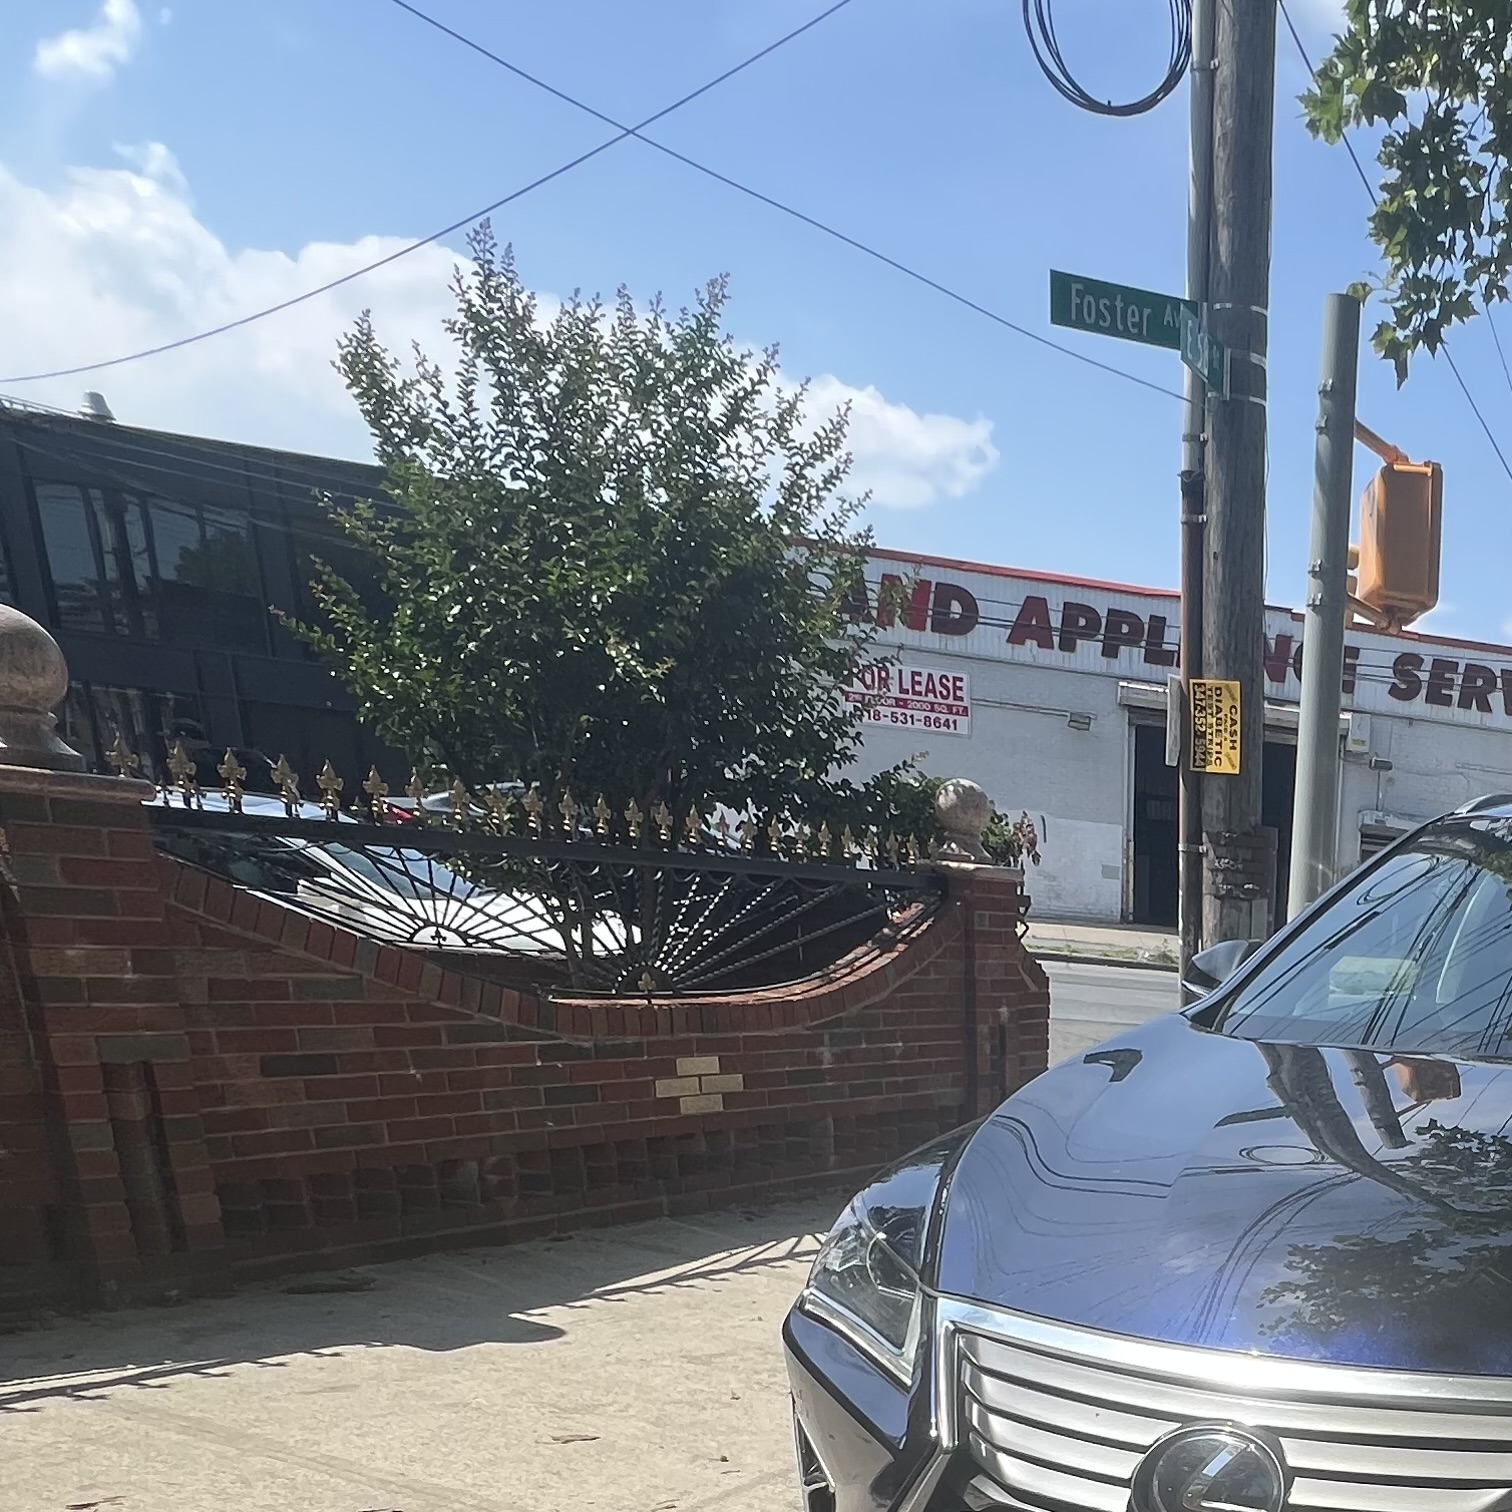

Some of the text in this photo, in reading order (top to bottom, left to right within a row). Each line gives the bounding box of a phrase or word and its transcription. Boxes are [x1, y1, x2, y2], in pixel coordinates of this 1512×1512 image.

[1070, 282, 1153, 337] Foster
[849, 662, 965, 702] OR LEASE
[860, 707, 958, 731] 18-531-8641
[1214, 686, 1223, 767] DIABETIC
[1229, 704, 1238, 751] CASH
